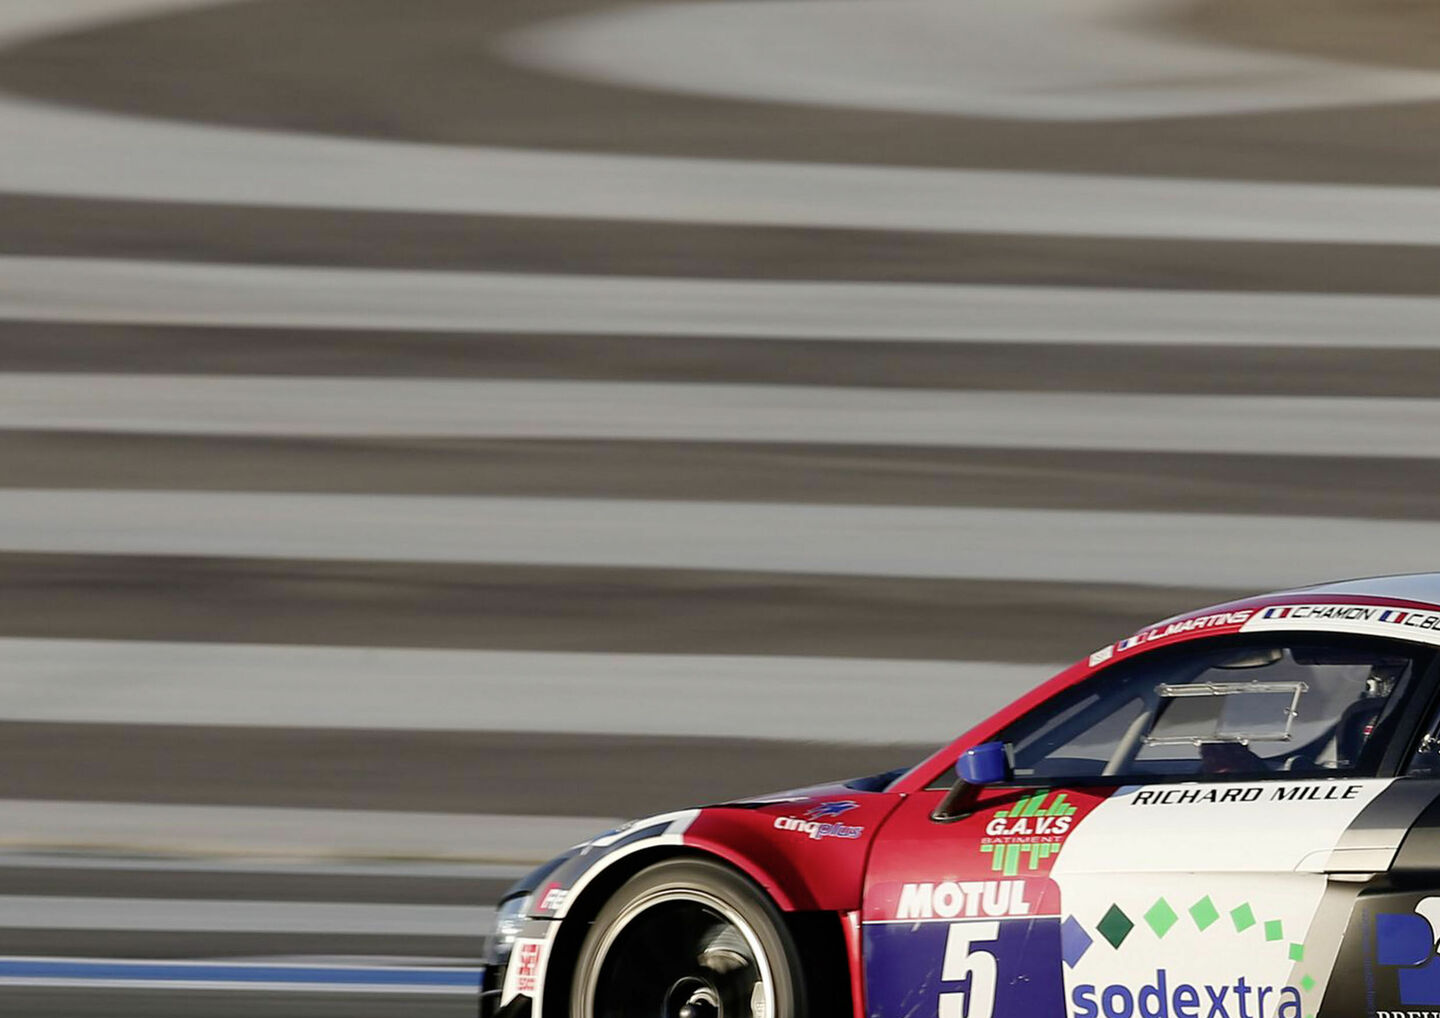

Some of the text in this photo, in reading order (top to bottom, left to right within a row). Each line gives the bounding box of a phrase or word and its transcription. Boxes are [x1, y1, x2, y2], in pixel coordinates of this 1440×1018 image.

[1131, 784, 1364, 806] RICHARD MILLE
[985, 816, 1073, 836] G.A.V.S
[896, 880, 1031, 919] MOTUL
